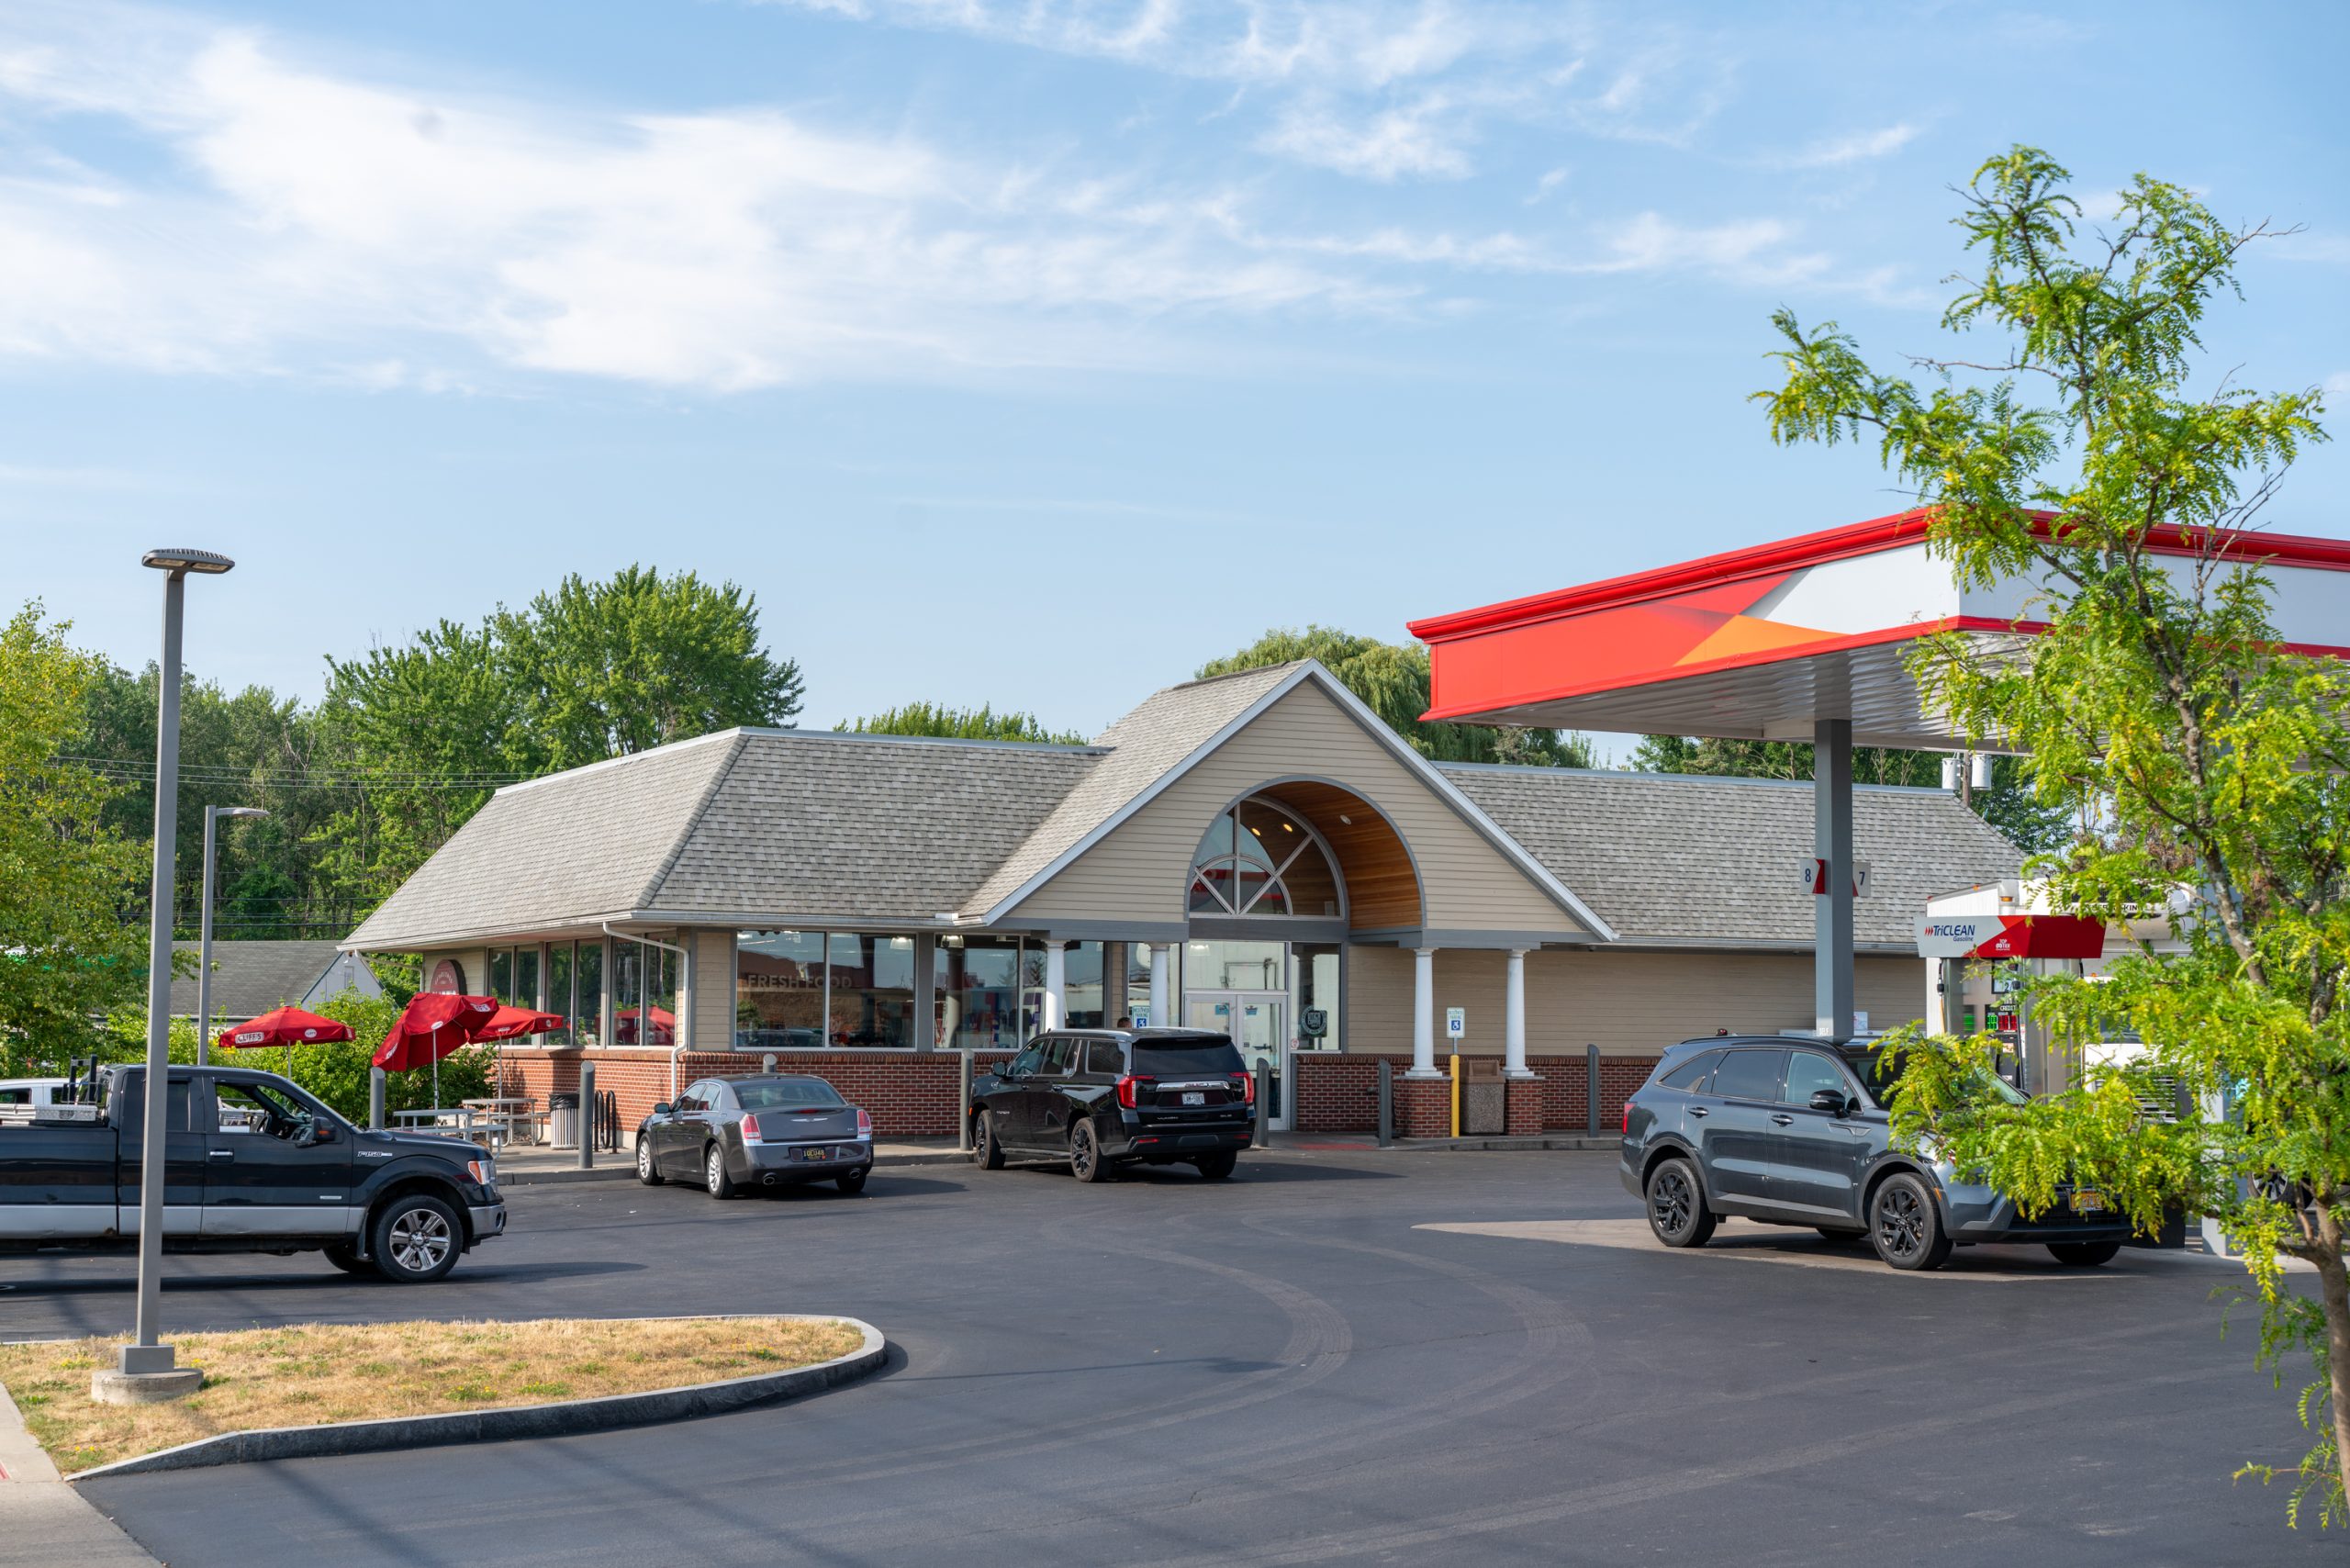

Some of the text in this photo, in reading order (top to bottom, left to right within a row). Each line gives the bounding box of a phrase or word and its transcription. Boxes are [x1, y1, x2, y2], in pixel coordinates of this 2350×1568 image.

[1805, 868, 1812, 883] 8
[1859, 871, 1866, 886] 7
[1932, 924, 1975, 936] TriCLEAN
[748, 974, 852, 989] FRESH FOOD
